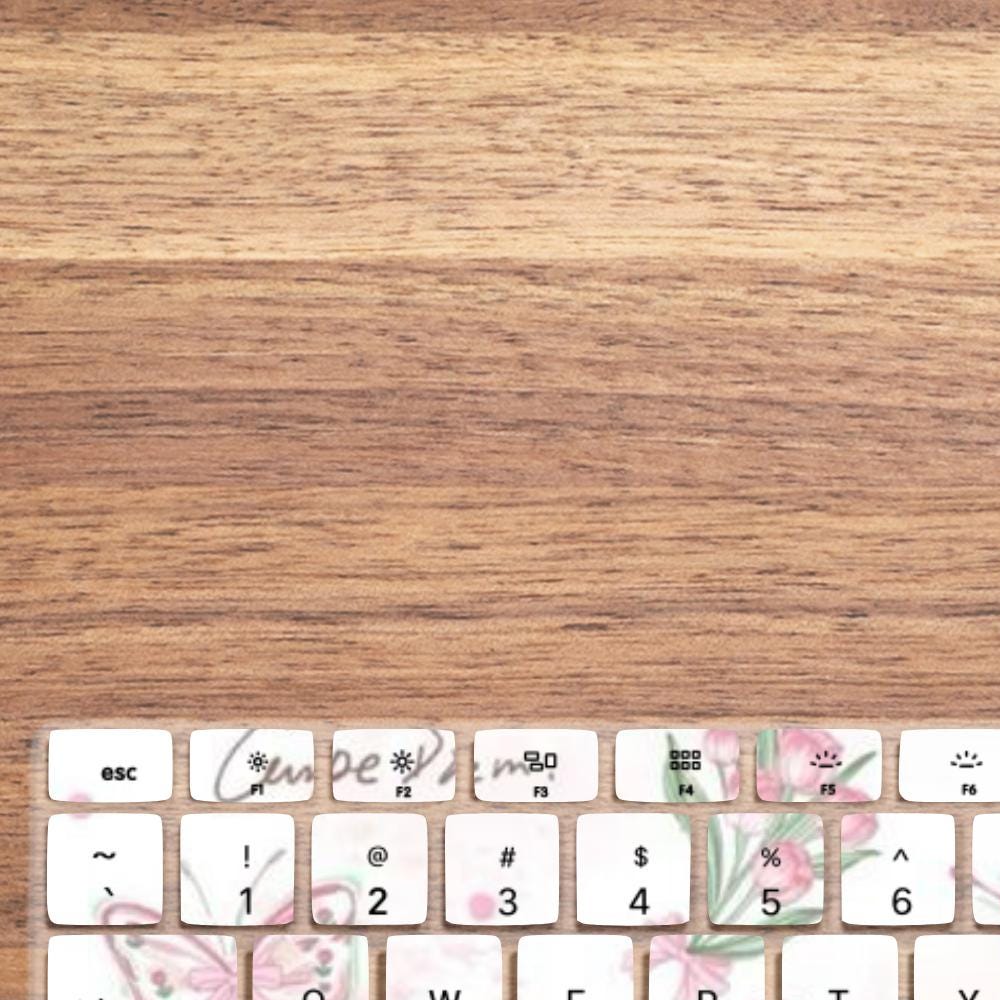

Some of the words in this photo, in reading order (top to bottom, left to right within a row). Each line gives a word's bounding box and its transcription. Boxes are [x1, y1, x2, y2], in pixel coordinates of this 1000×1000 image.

[101, 767, 136, 781] esc
[250, 783, 264, 796] F1
[396, 786, 412, 798] F2
[534, 786, 548, 798] F3
[678, 783, 694, 796] F4
[820, 783, 836, 796] F5
[962, 784, 977, 795] F6
[243, 845, 250, 866] !
[367, 846, 388, 867] @
[500, 847, 515, 866] #
[634, 845, 648, 868] $
[761, 847, 781, 867] %
[240, 887, 251, 915] 1
[368, 887, 387, 915] 2
[499, 887, 517, 916] 3
[629, 888, 649, 915] 4
[762, 888, 781, 916] 5
[892, 887, 912, 916] 6
